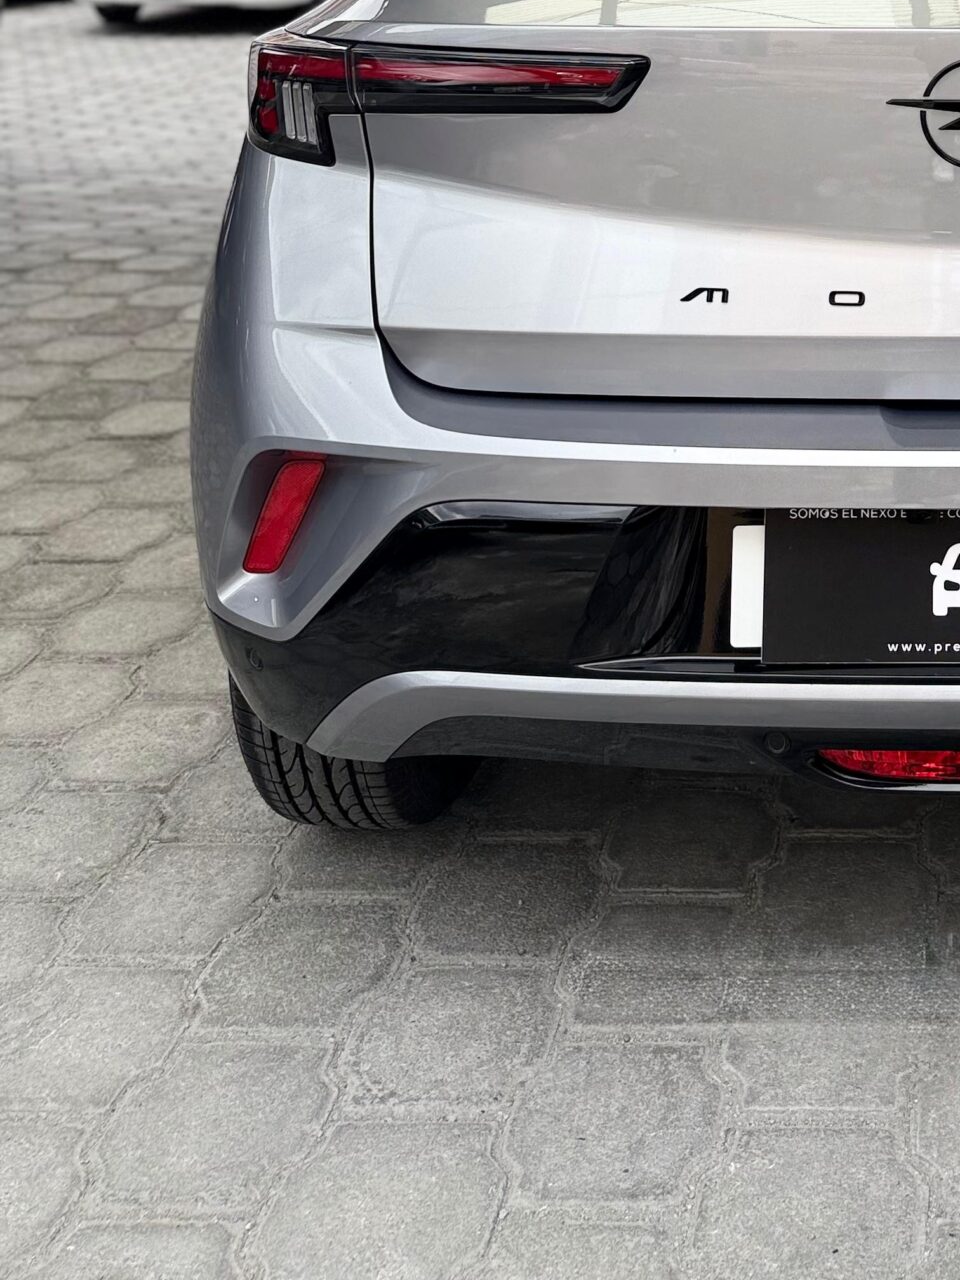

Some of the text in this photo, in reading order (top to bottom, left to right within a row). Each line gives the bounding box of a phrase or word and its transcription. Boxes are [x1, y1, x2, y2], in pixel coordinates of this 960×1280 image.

[789, 507, 839, 520] SOMOS
[841, 508, 858, 519] EL
[860, 508, 897, 519] NEXO
